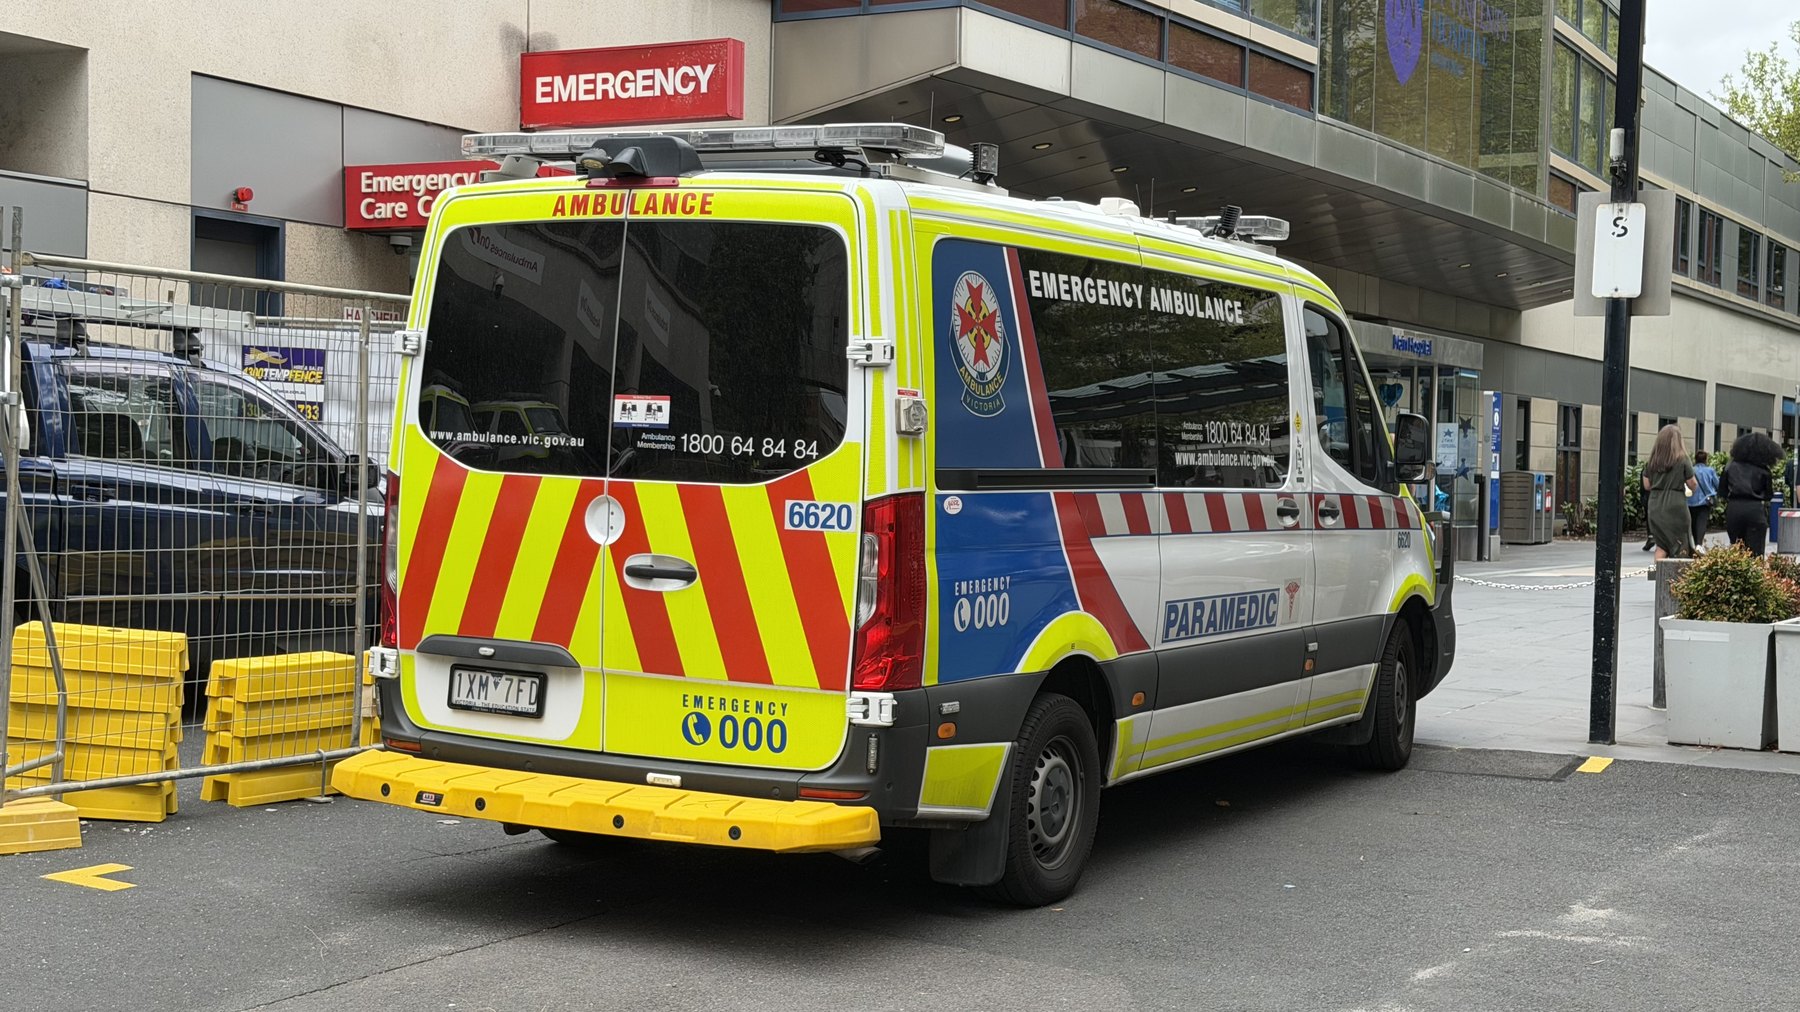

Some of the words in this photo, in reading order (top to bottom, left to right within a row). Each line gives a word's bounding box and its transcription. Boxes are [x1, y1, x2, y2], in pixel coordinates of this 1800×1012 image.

[535, 63, 716, 104] EMERGENCY
[360, 171, 476, 196] Emergency
[360, 197, 408, 219] Care
[552, 192, 714, 217] AMBULANCE
[1028, 269, 1143, 309] EMERGENCY
[1150, 286, 1244, 324] AMBULANCE
[960, 366, 1003, 396] AMBULANCE
[966, 394, 1001, 411] VICTORIA
[430, 429, 585, 448] www.ambulance.vic.gov.au
[637, 440, 676, 451] Membership
[641, 432, 676, 442] Ambulance
[1205, 420, 1228, 444] 1800
[1230, 422, 1243, 445] 64
[1245, 423, 1257, 446] 84
[1259, 424, 1271, 446] 84
[680, 433, 724, 455] 1800
[731, 436, 755, 456] 64
[761, 437, 787, 458] 84
[793, 439, 819, 460] 84
[1174, 449, 1275, 470] www.ambulance.vic.gov.au
[789, 502, 852, 530] 6620
[1397, 531, 1411, 549] 6620
[954, 575, 1011, 596] EMERGENCY
[974, 592, 1010, 630] 000
[1164, 592, 1277, 639] PARAMEDIC
[457, 672, 490, 701] 1XM
[504, 677, 538, 706] 7FD
[682, 693, 788, 717] EMERGENCY
[718, 714, 788, 754] 000
